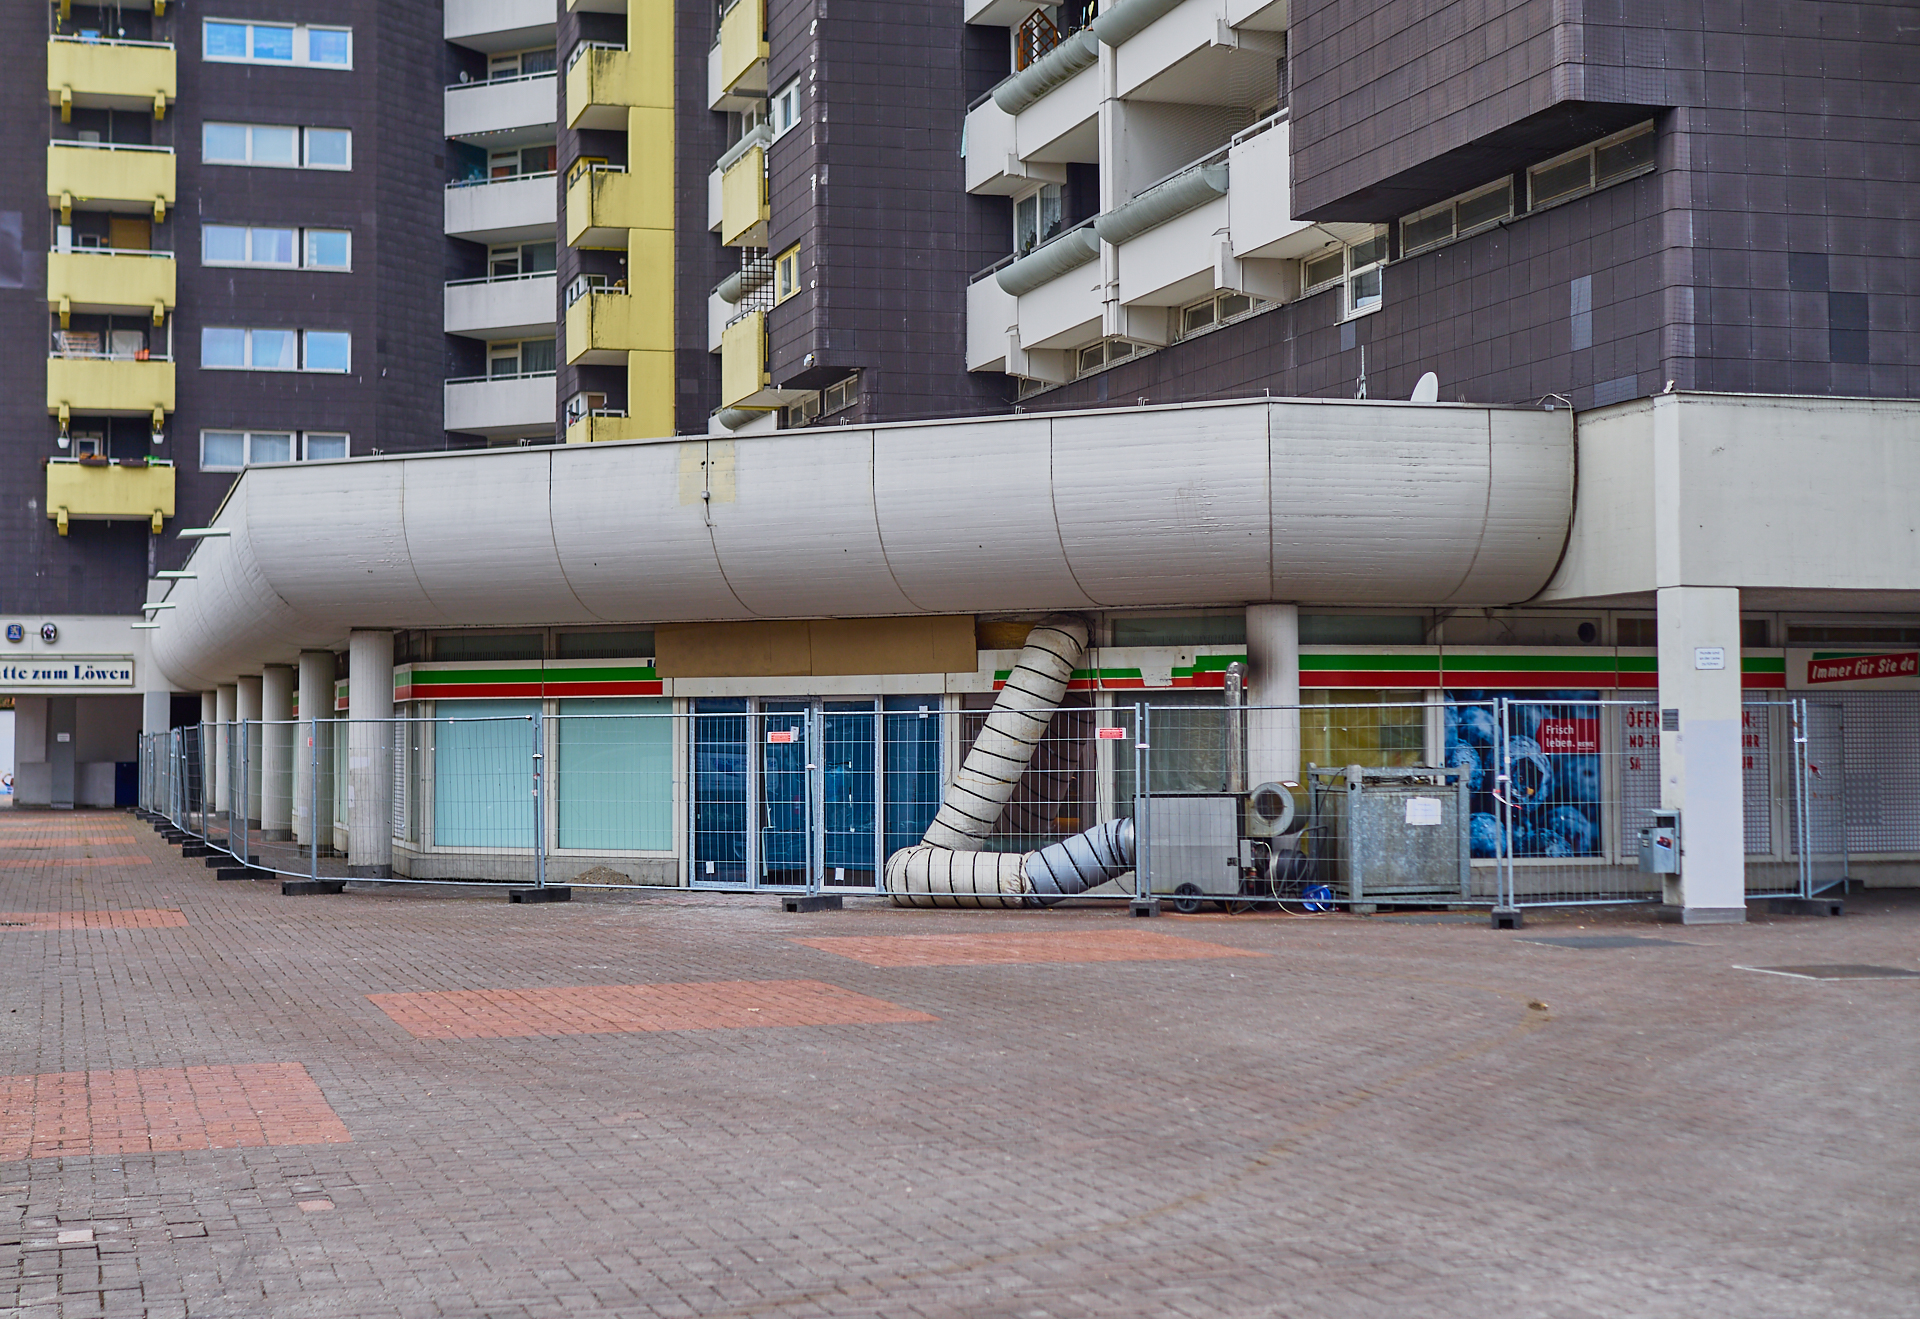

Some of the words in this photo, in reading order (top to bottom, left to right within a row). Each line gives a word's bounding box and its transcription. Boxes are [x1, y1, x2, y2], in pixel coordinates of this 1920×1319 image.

[0, 665, 27, 680] tte
[32, 669, 68, 680] zum
[74, 665, 130, 680] Löwen
[1812, 665, 1852, 679] Immer
[1854, 659, 1875, 676] für
[1878, 658, 1897, 674] Sie
[1900, 656, 1915, 671] da
[1546, 725, 1574, 735] Frisch
[1546, 738, 1575, 748] leben.
